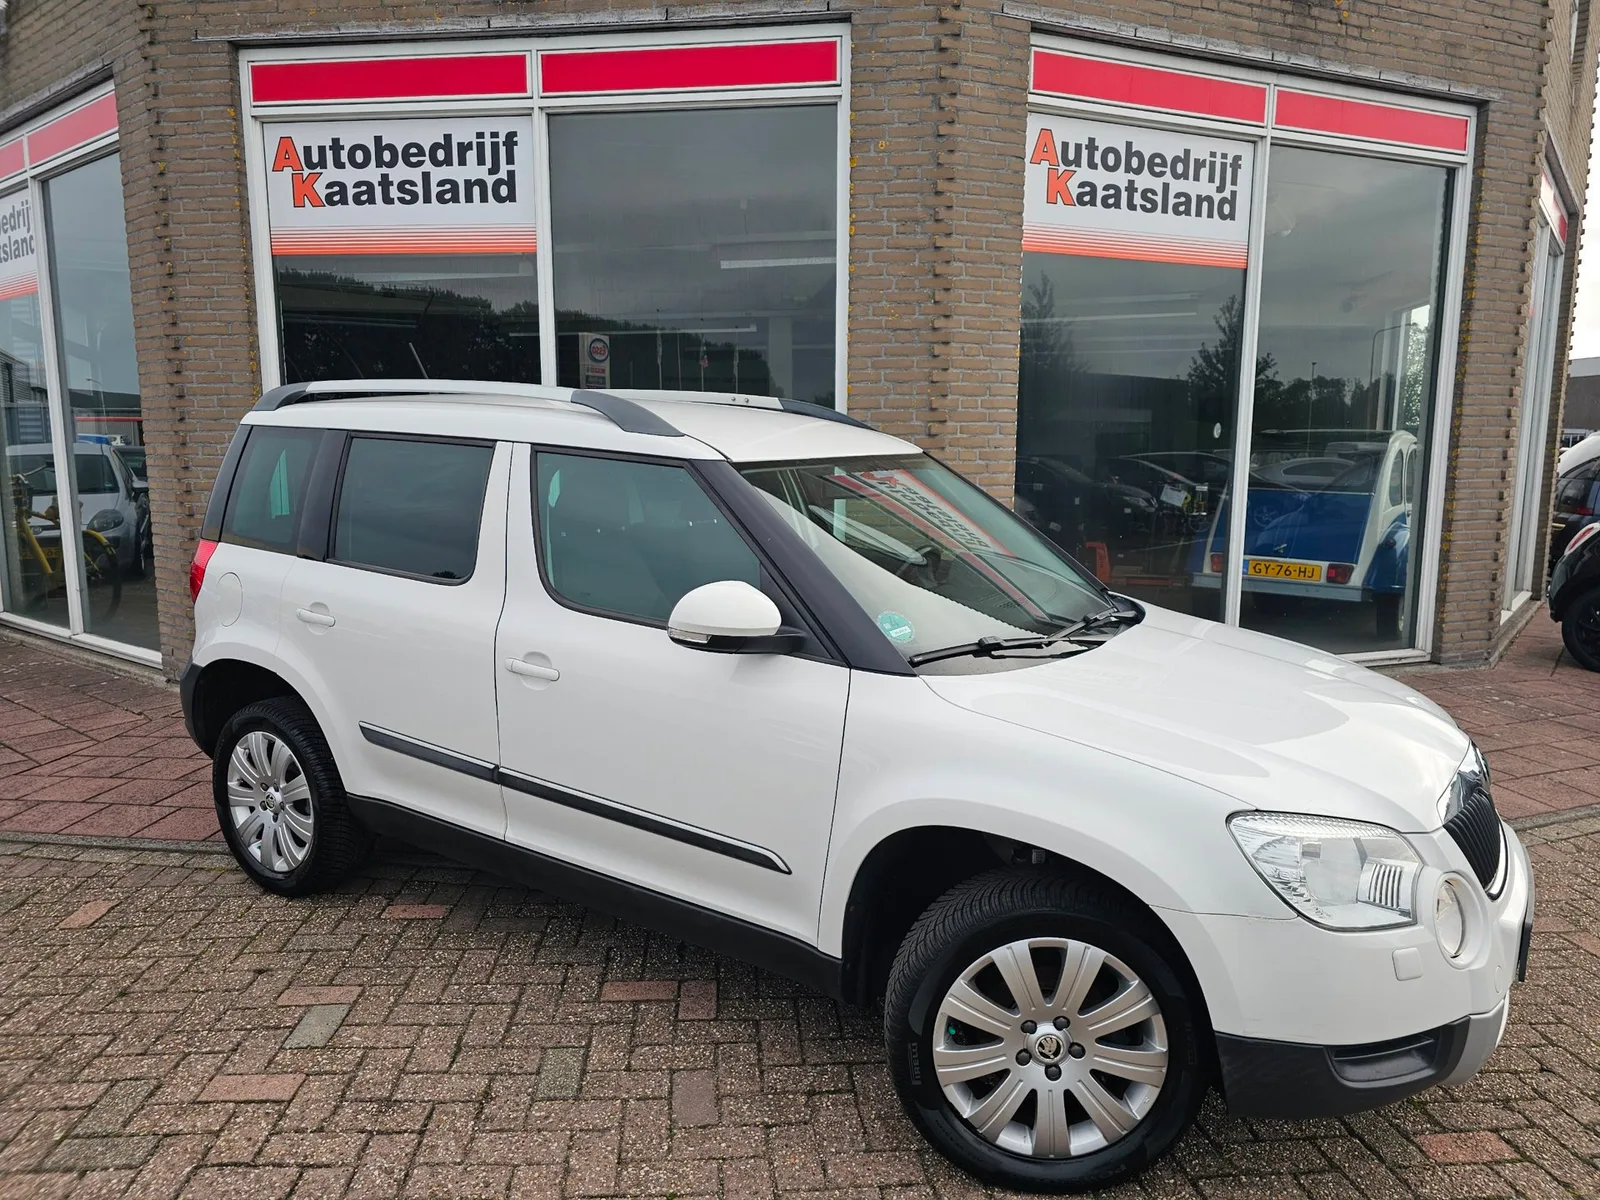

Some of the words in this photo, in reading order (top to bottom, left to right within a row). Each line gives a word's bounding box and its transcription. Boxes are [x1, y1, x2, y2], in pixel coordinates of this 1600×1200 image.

[272, 131, 518, 175] Autobedrijf
[1029, 128, 1242, 194] Autobedrijf
[292, 170, 517, 208] Kaatsland
[1046, 167, 1237, 221] Kaatsland
[0, 199, 32, 235] edrij
[0, 234, 35, 263] slan
[1252, 562, 1315, 579] GY-76-HJ
